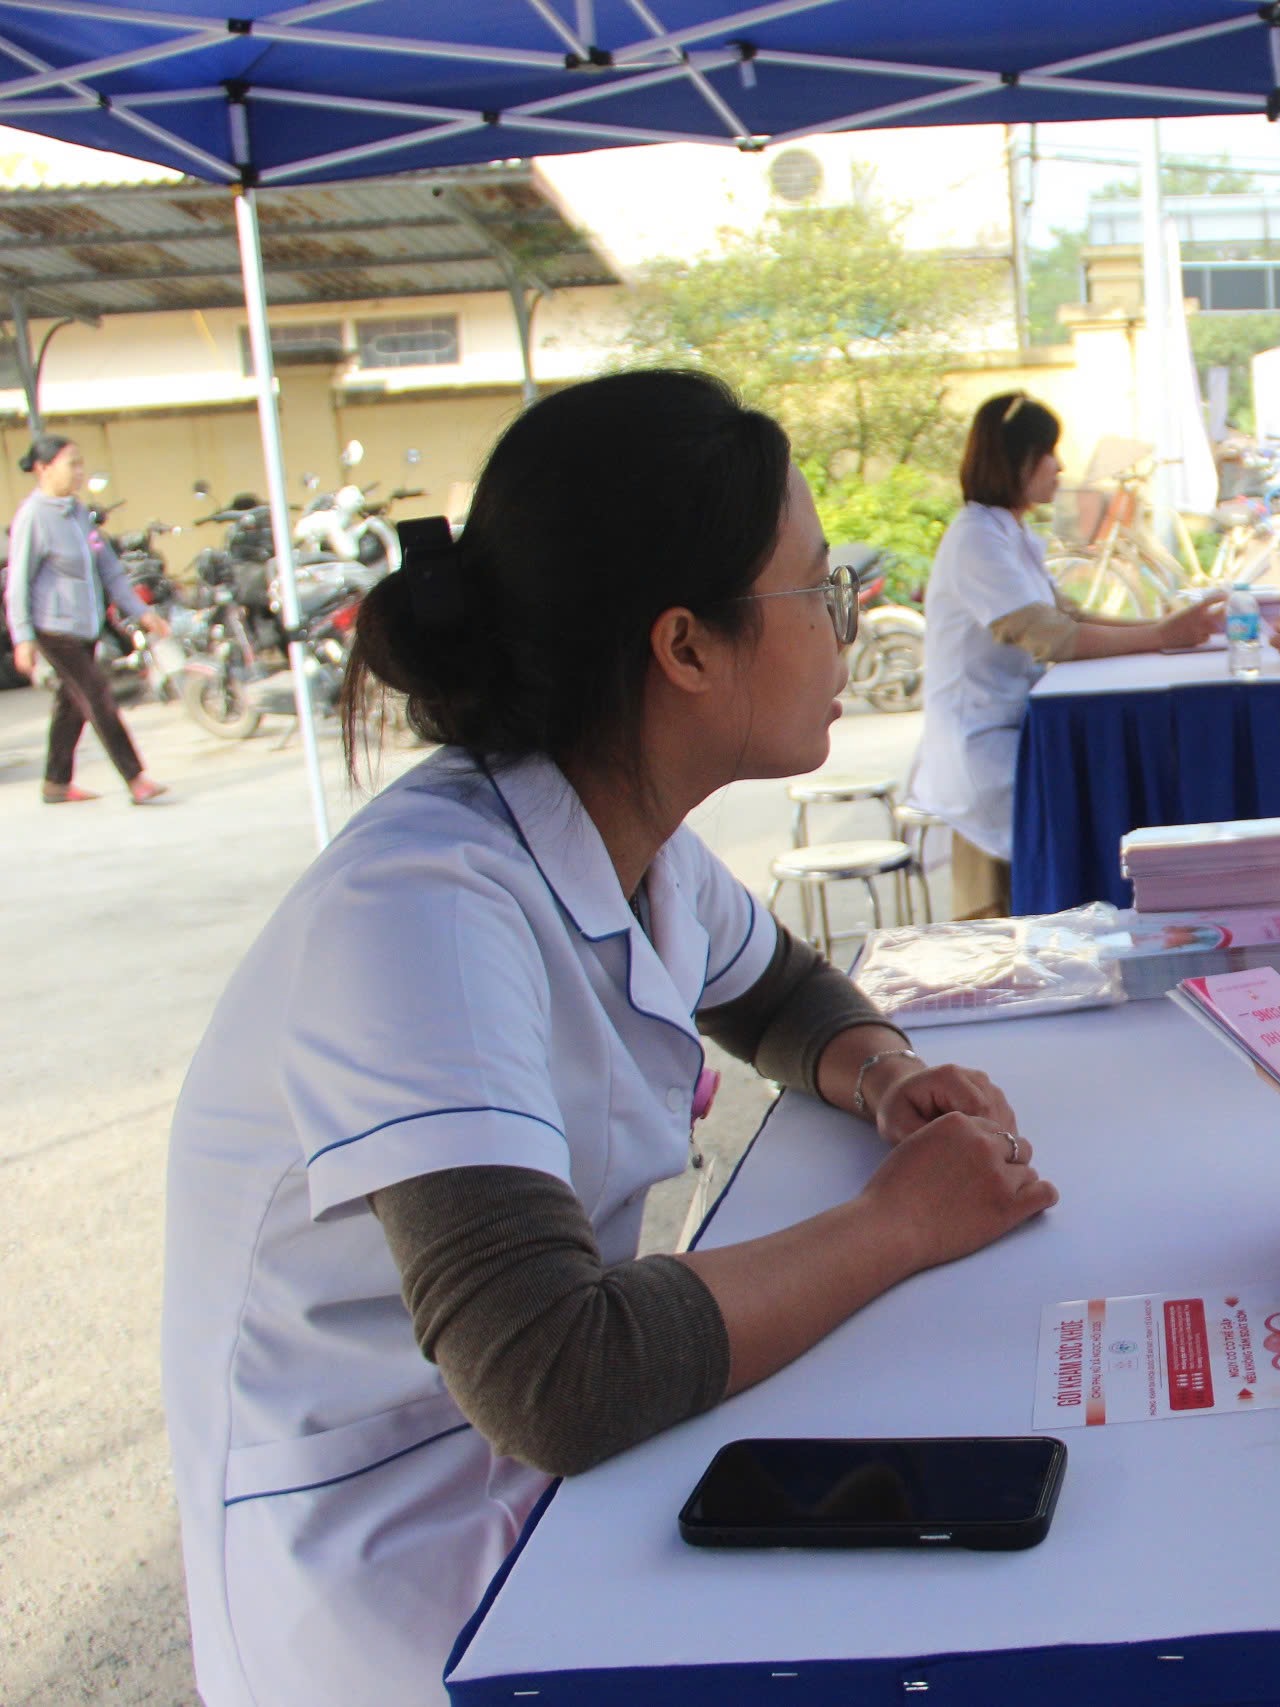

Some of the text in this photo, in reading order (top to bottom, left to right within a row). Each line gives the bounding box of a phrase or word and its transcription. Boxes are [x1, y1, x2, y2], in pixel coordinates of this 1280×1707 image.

[1224, 1341, 1236, 1351] CÓ
[1053, 1319, 1084, 1407] GÓI KHÁM SỨC KHỎE
[1241, 1350, 1255, 1371] KHÔNG
[1228, 1362, 1239, 1378] NGUY
[1091, 1385, 1101, 1399] CHO
